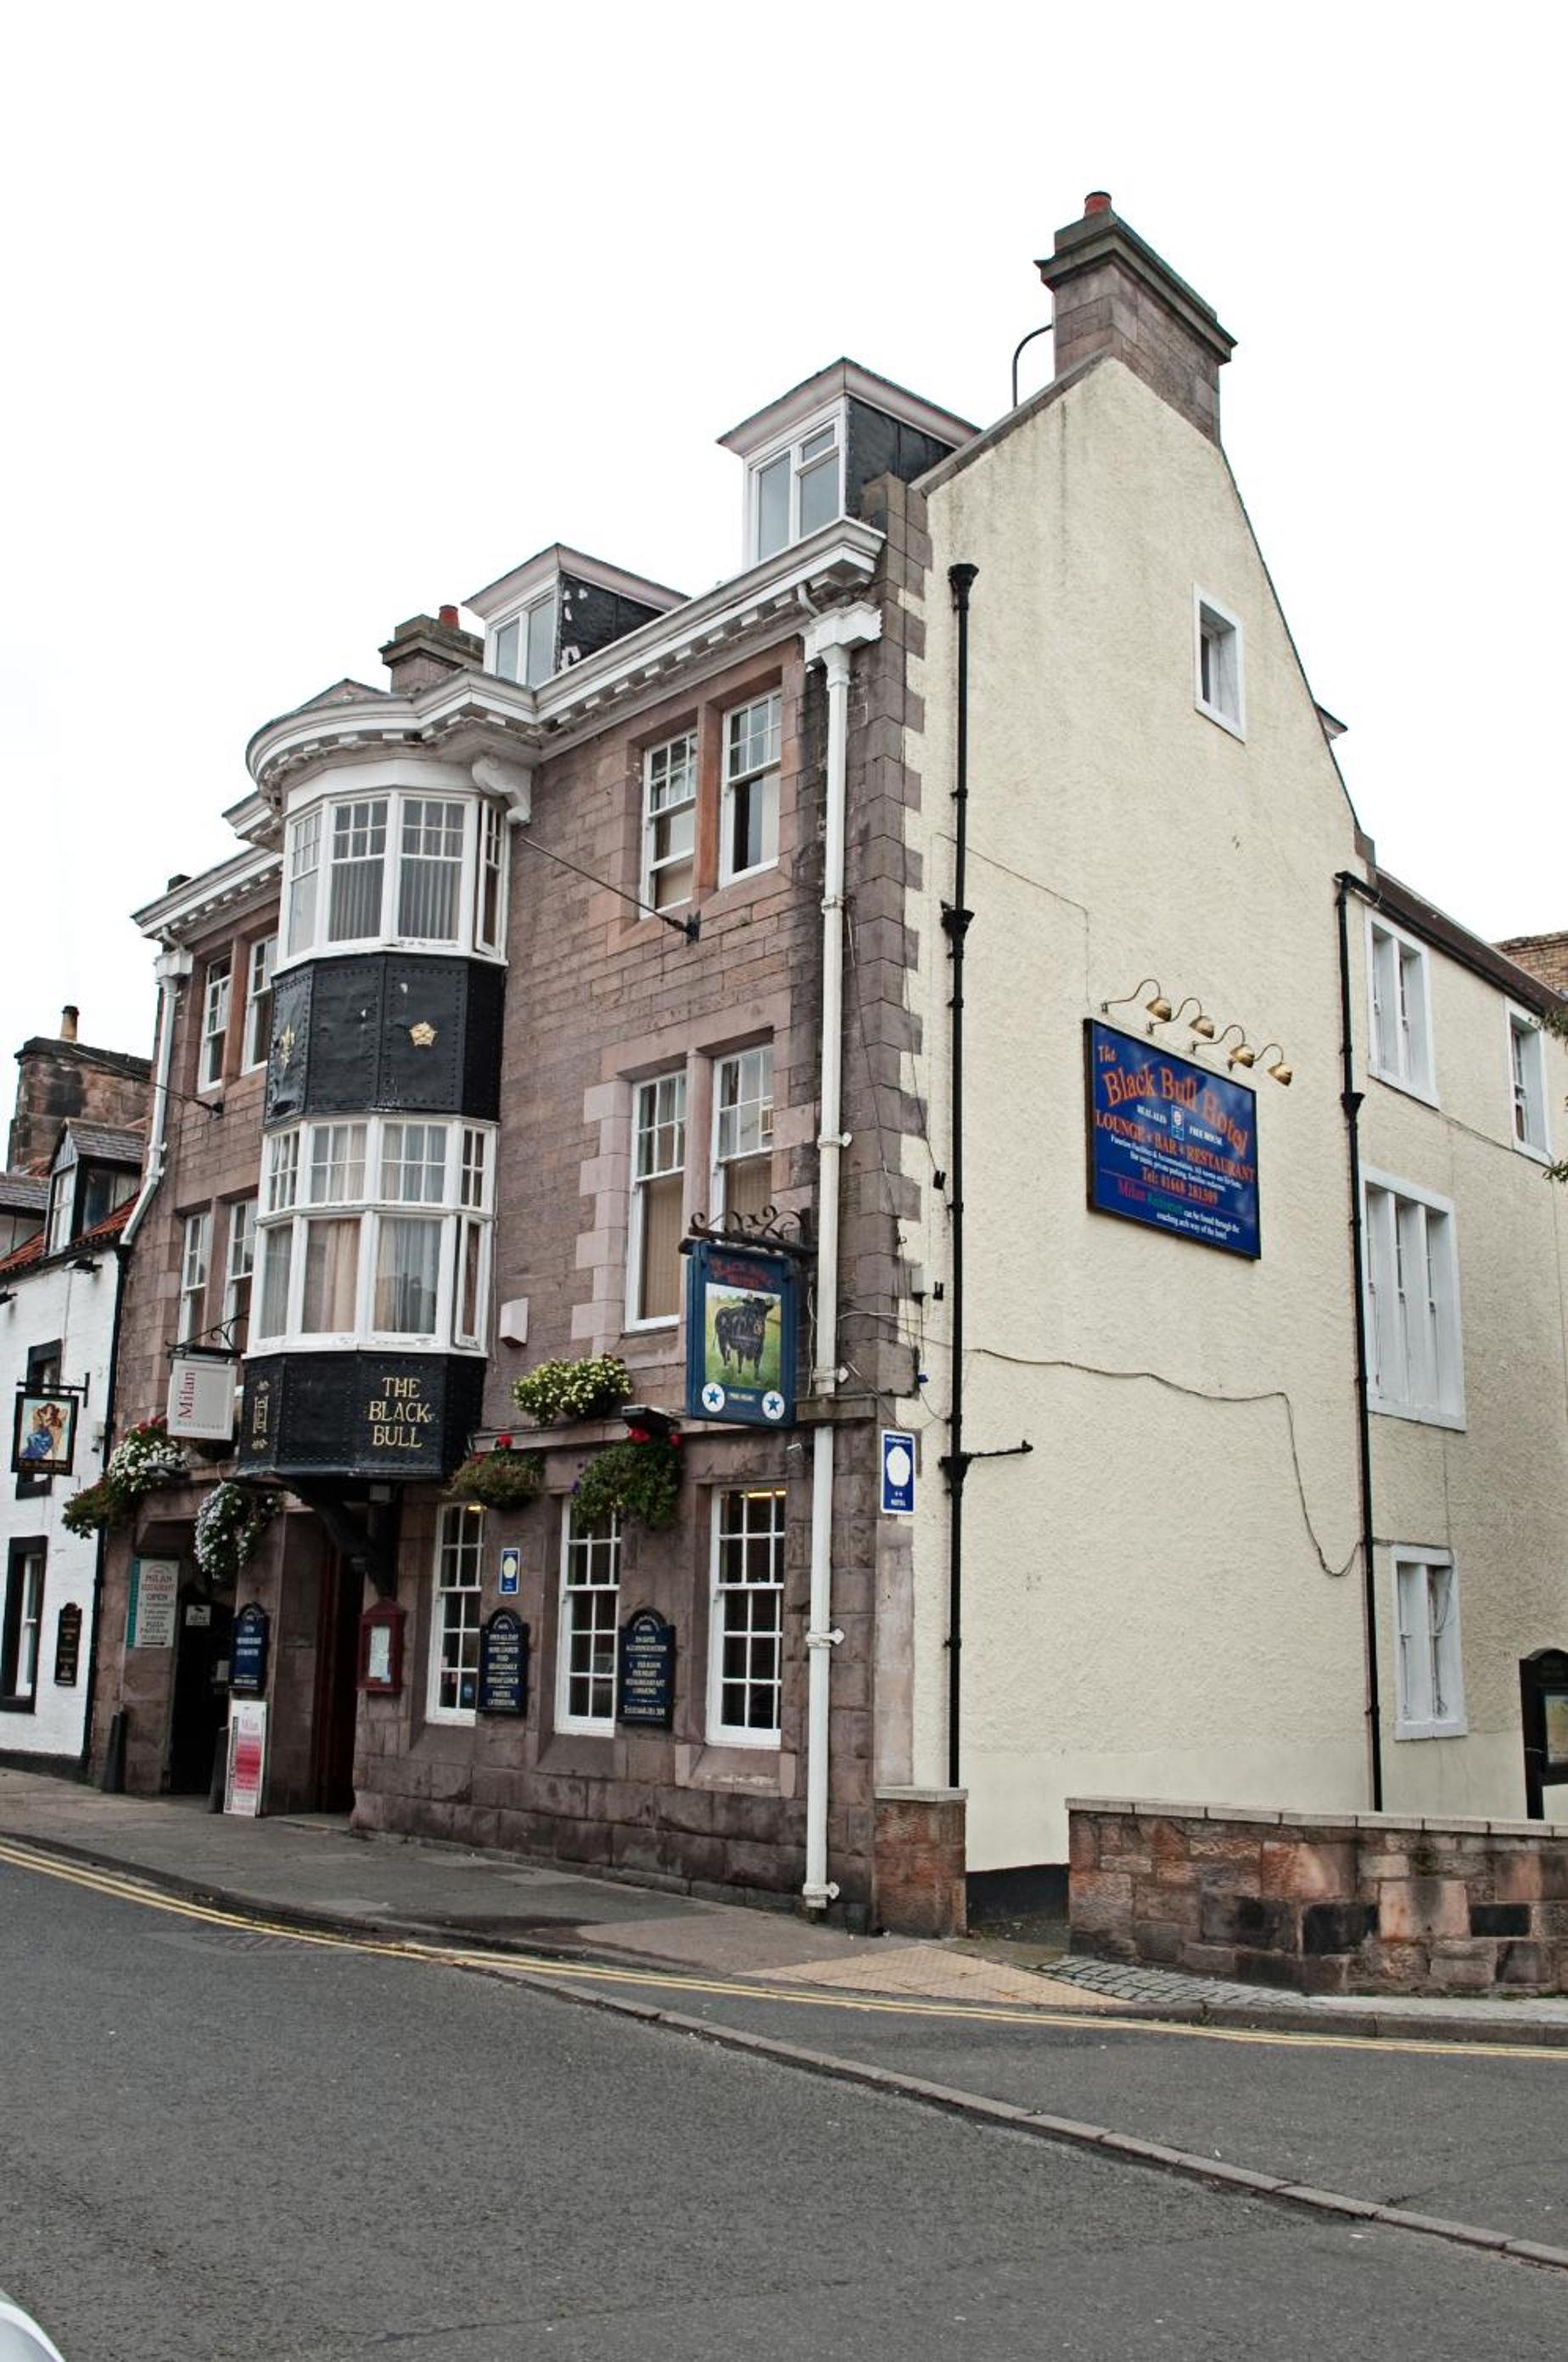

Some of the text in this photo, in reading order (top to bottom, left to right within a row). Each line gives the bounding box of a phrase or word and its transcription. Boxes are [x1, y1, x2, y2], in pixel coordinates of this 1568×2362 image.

[1098, 1045, 1117, 1063] The
[1102, 1063, 1248, 1157] Black Bull Hotel
[1095, 1109, 1145, 1142] LOUNGE
[1154, 1133, 1178, 1156] BAR
[1187, 1145, 1255, 1183] RESTAURANT
[177, 1372, 196, 1419] Milan
[381, 1377, 422, 1398] THE
[368, 1400, 432, 1423] BLACK
[372, 1425, 423, 1448] BULL
